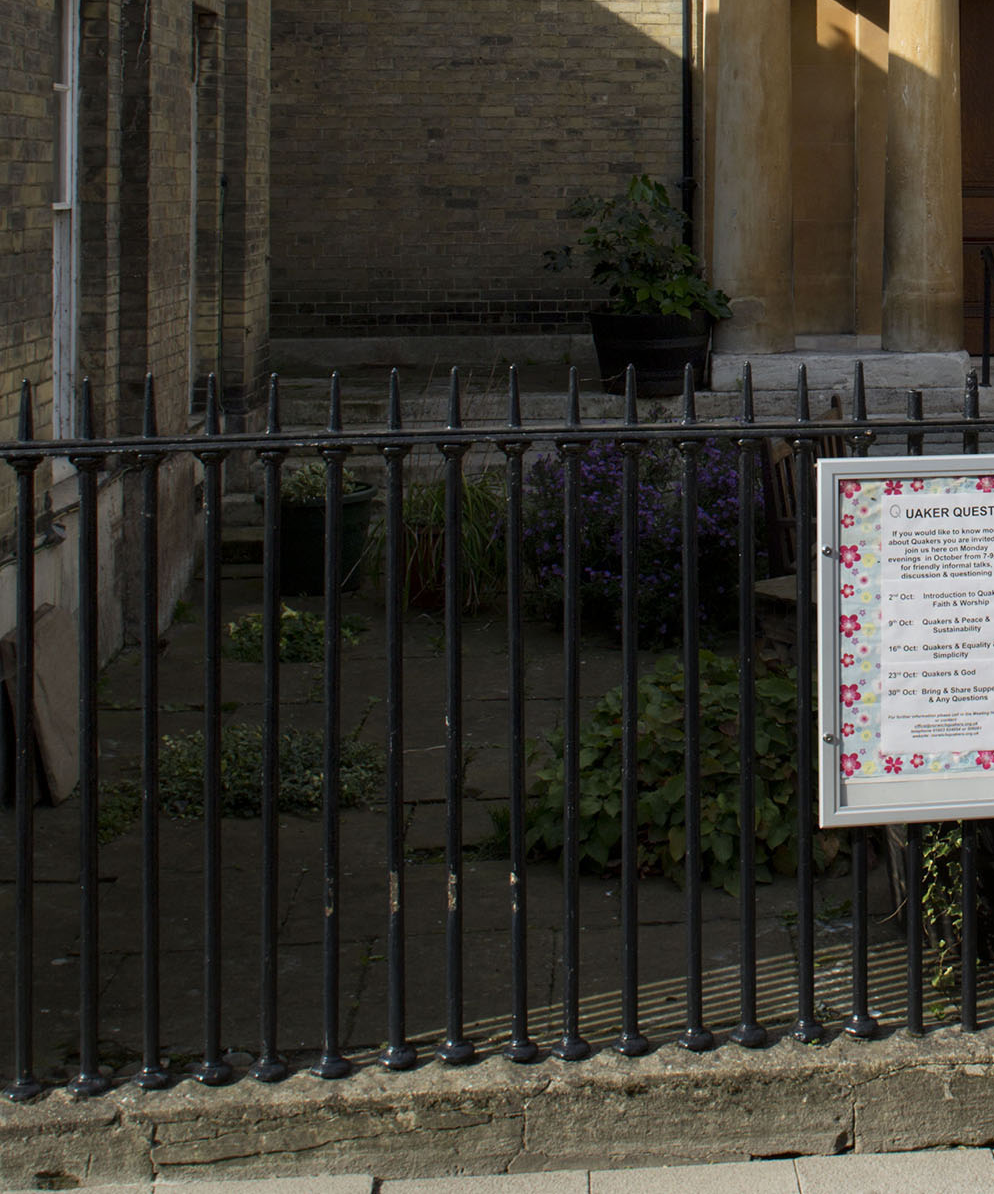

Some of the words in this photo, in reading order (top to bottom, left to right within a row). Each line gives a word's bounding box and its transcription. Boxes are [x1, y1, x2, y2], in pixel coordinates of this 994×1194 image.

[906, 507, 950, 518] UAKER
[953, 506, 994, 516] QUEST
[950, 570, 992, 578] questioning
